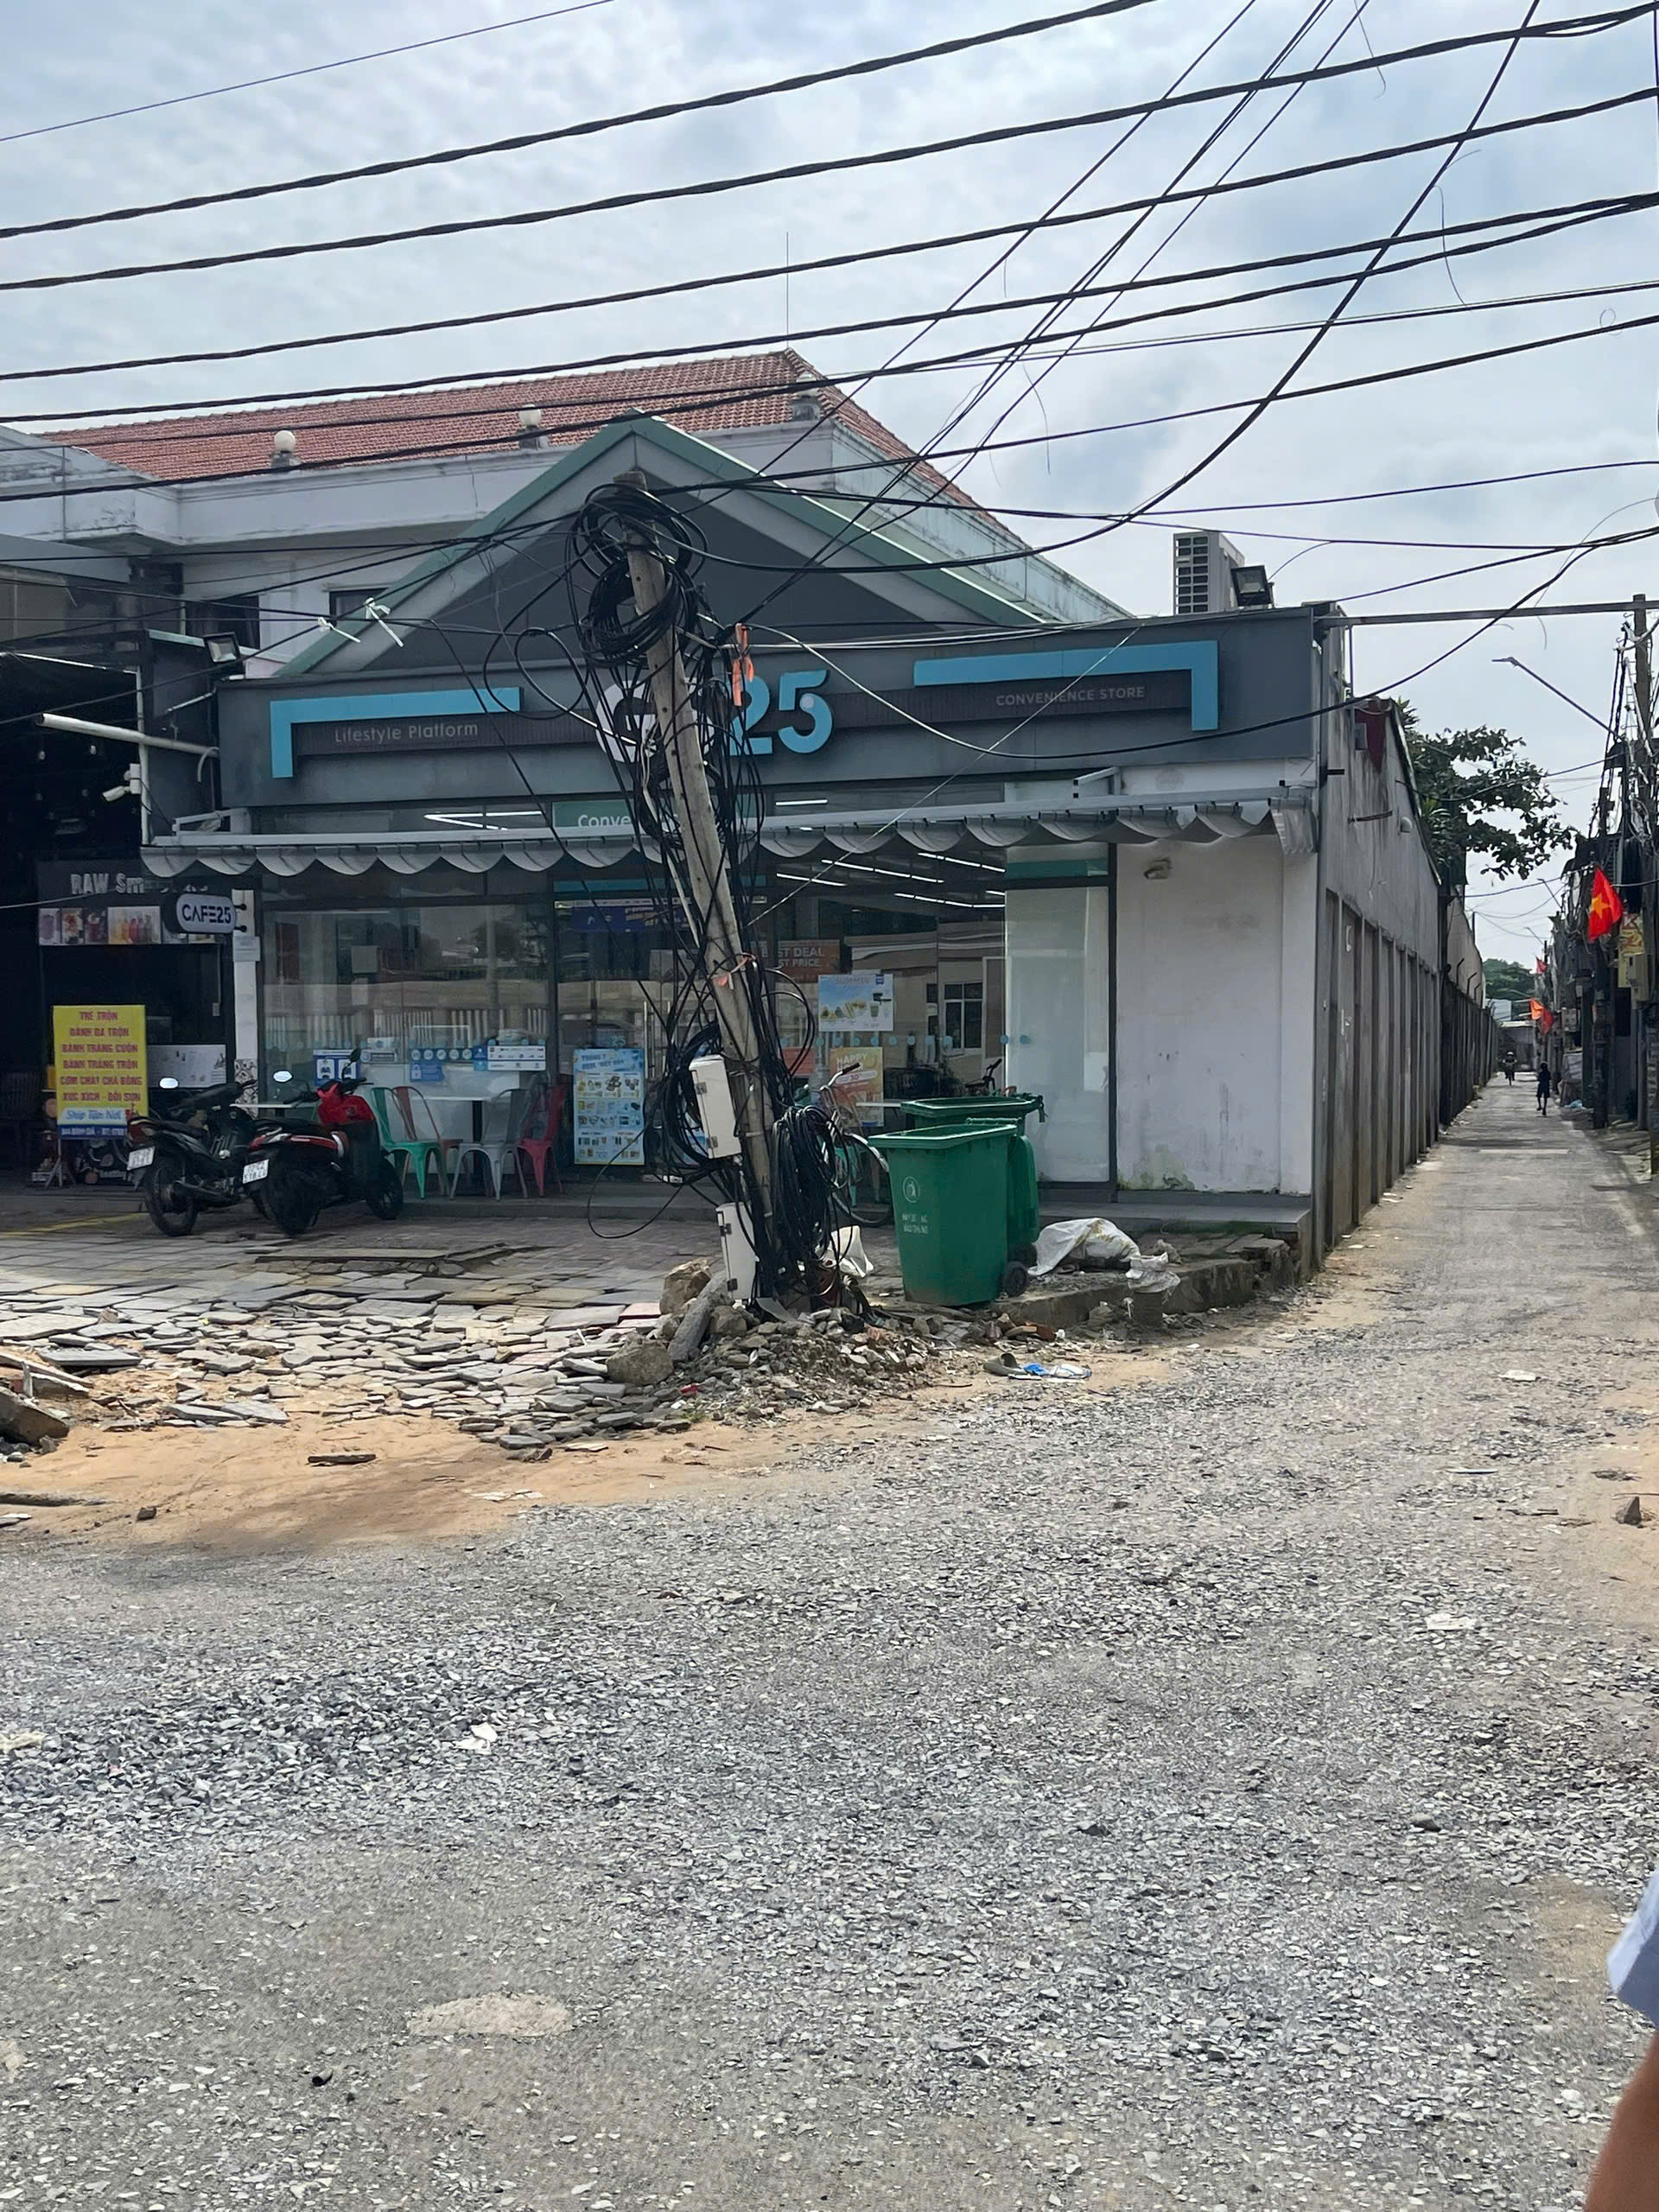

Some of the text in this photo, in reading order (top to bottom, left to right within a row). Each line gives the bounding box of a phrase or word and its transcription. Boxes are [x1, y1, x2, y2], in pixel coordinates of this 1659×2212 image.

[995, 686, 1146, 706] CONVENIENCE STORE
[334, 722, 478, 744] Lifestyle Platform
[71, 873, 110, 894] RAW
[181, 903, 232, 924] CAFE25
[793, 946, 825, 957] DEAL
[792, 958, 821, 967] PRICE
[836, 1053, 868, 1065] HAPPY
